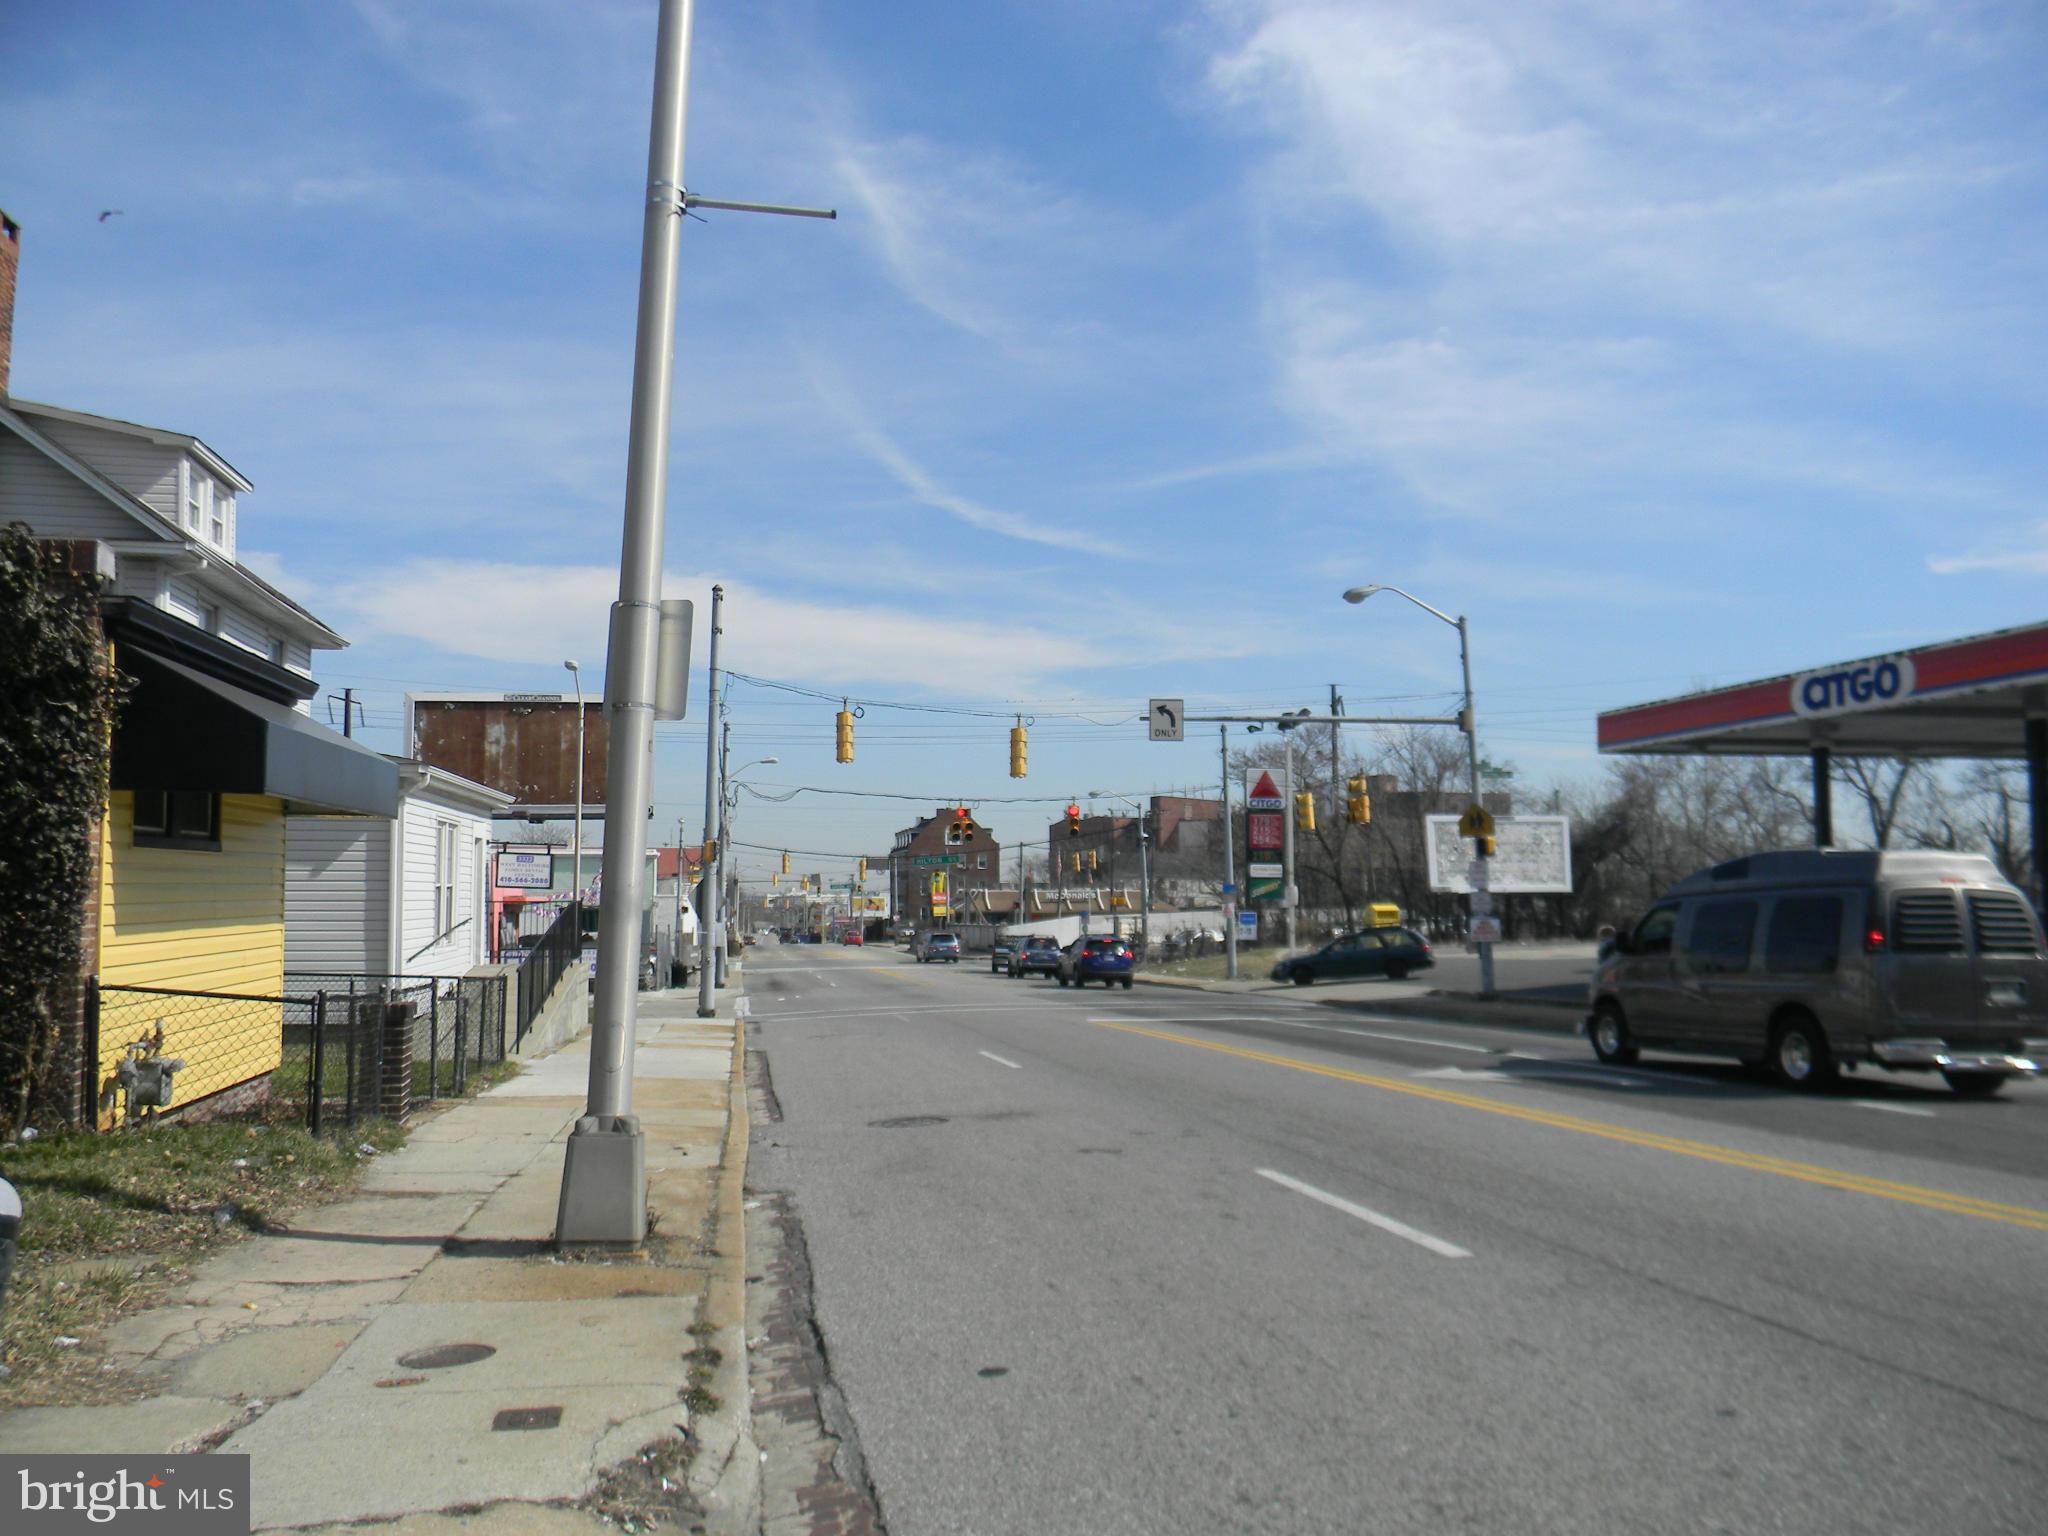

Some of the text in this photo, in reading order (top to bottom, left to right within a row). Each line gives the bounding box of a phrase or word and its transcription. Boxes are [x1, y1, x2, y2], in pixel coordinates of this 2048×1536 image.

[1803, 663, 1899, 710] CITGO
[1155, 729, 1176, 737] ONLY
[1250, 799, 1281, 808] CITGO
